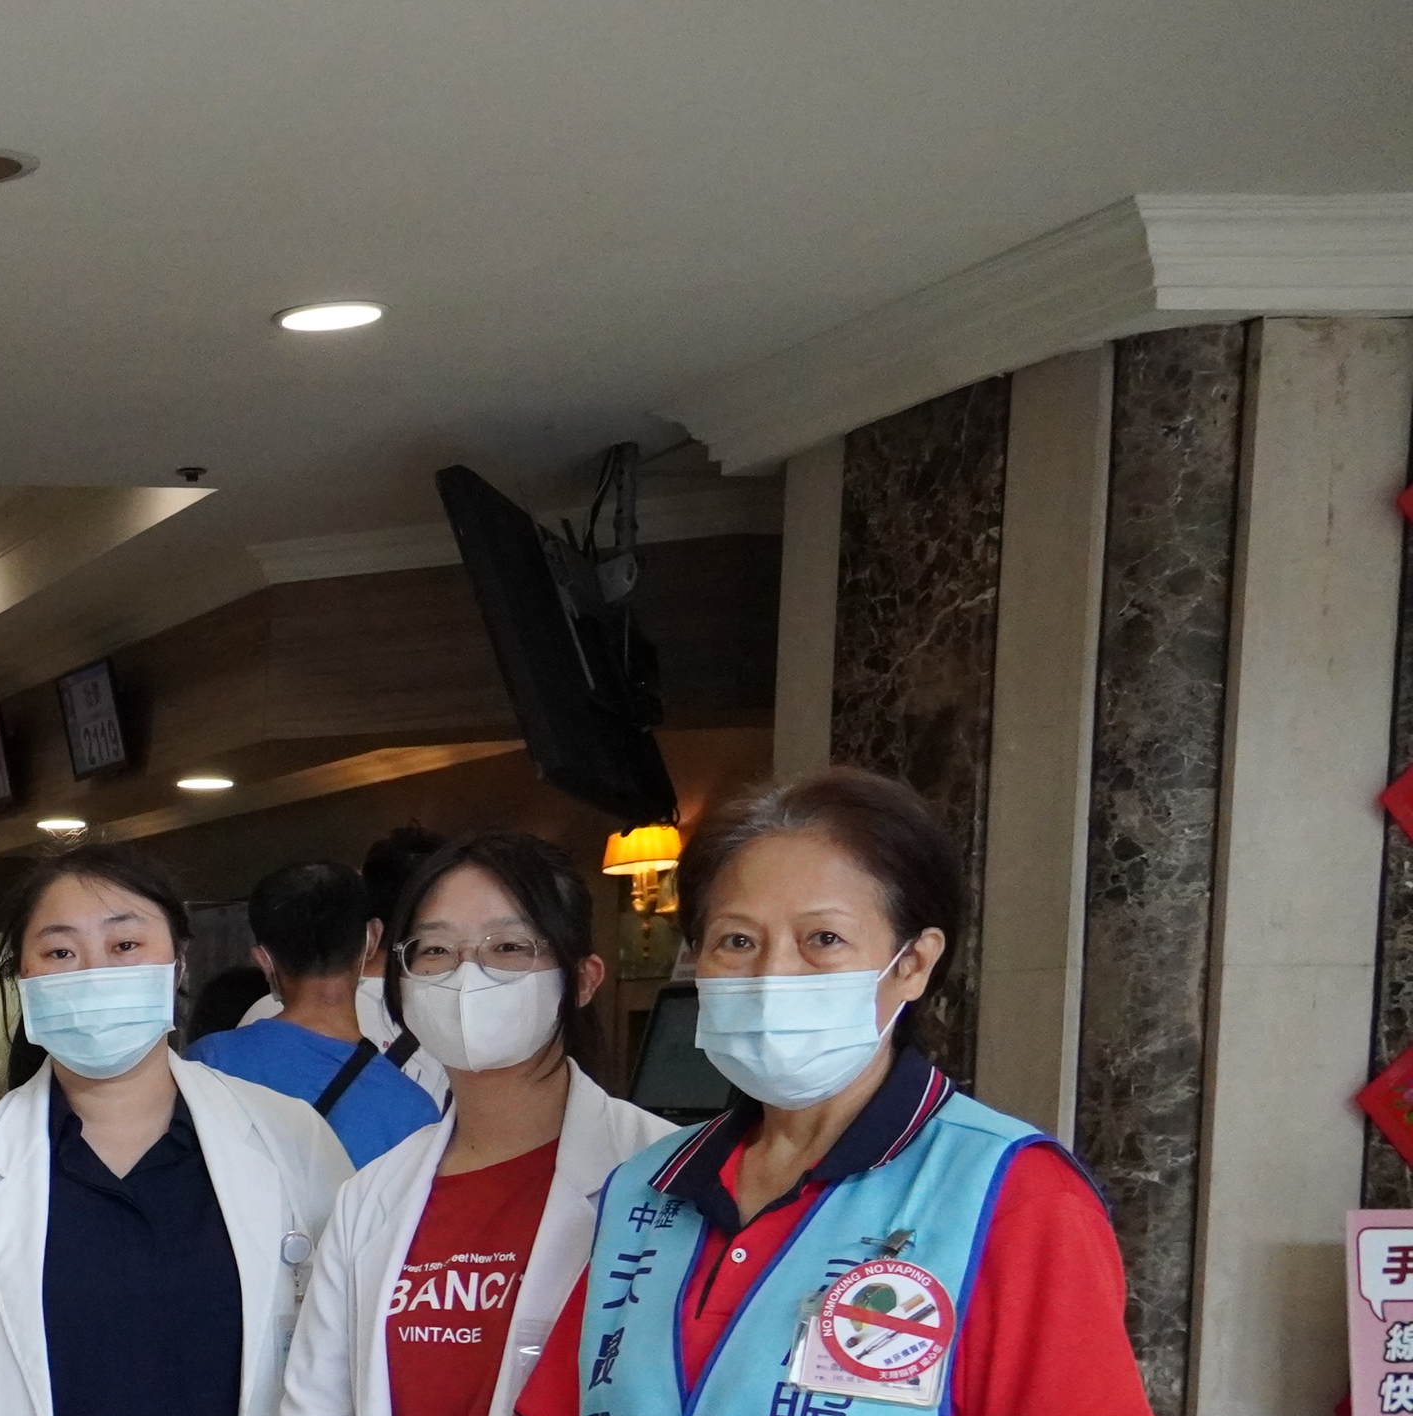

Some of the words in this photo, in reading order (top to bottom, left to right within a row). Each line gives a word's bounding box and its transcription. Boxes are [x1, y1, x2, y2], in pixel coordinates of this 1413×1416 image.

[470, 1253, 492, 1264] New
[493, 1252, 516, 1262] York
[864, 1264, 885, 1276] NO
[886, 1263, 932, 1288] VAPING
[386, 1269, 517, 1317] BANC
[824, 1272, 861, 1319] SMOKING
[398, 1326, 482, 1344] VINTAGE
[823, 1320, 834, 1338] NO
